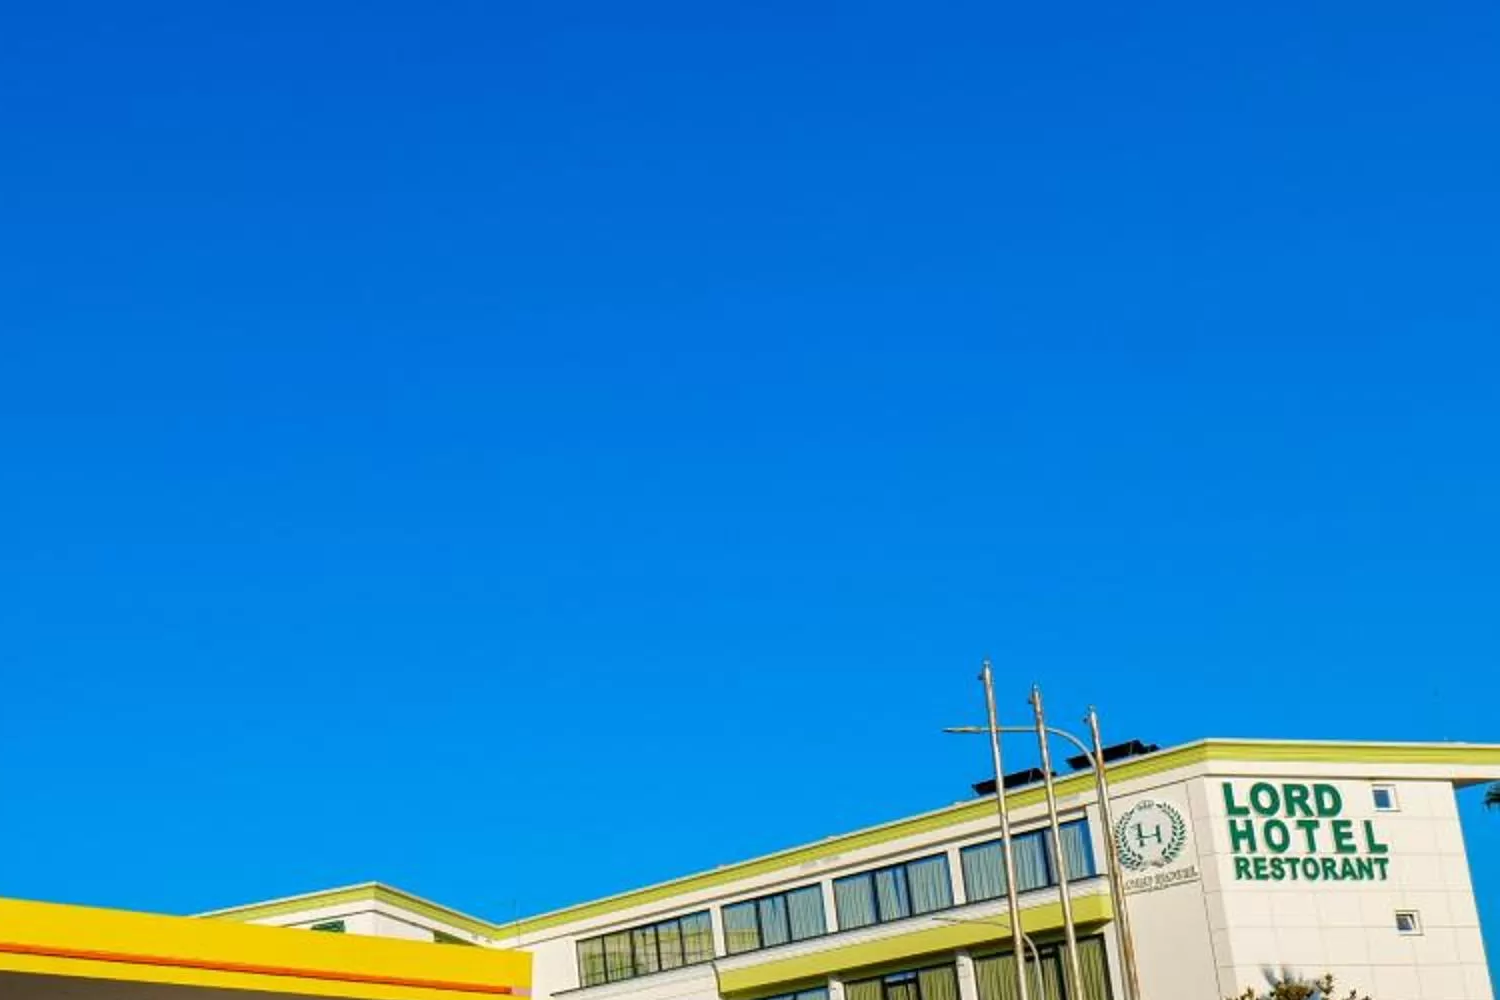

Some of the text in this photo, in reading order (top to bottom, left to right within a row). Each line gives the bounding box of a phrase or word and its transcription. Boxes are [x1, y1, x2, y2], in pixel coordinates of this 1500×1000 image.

[1221, 781, 1343, 818] LORD
[1227, 818, 1389, 854] HOTEL
[1233, 856, 1390, 881] RESTORANT
